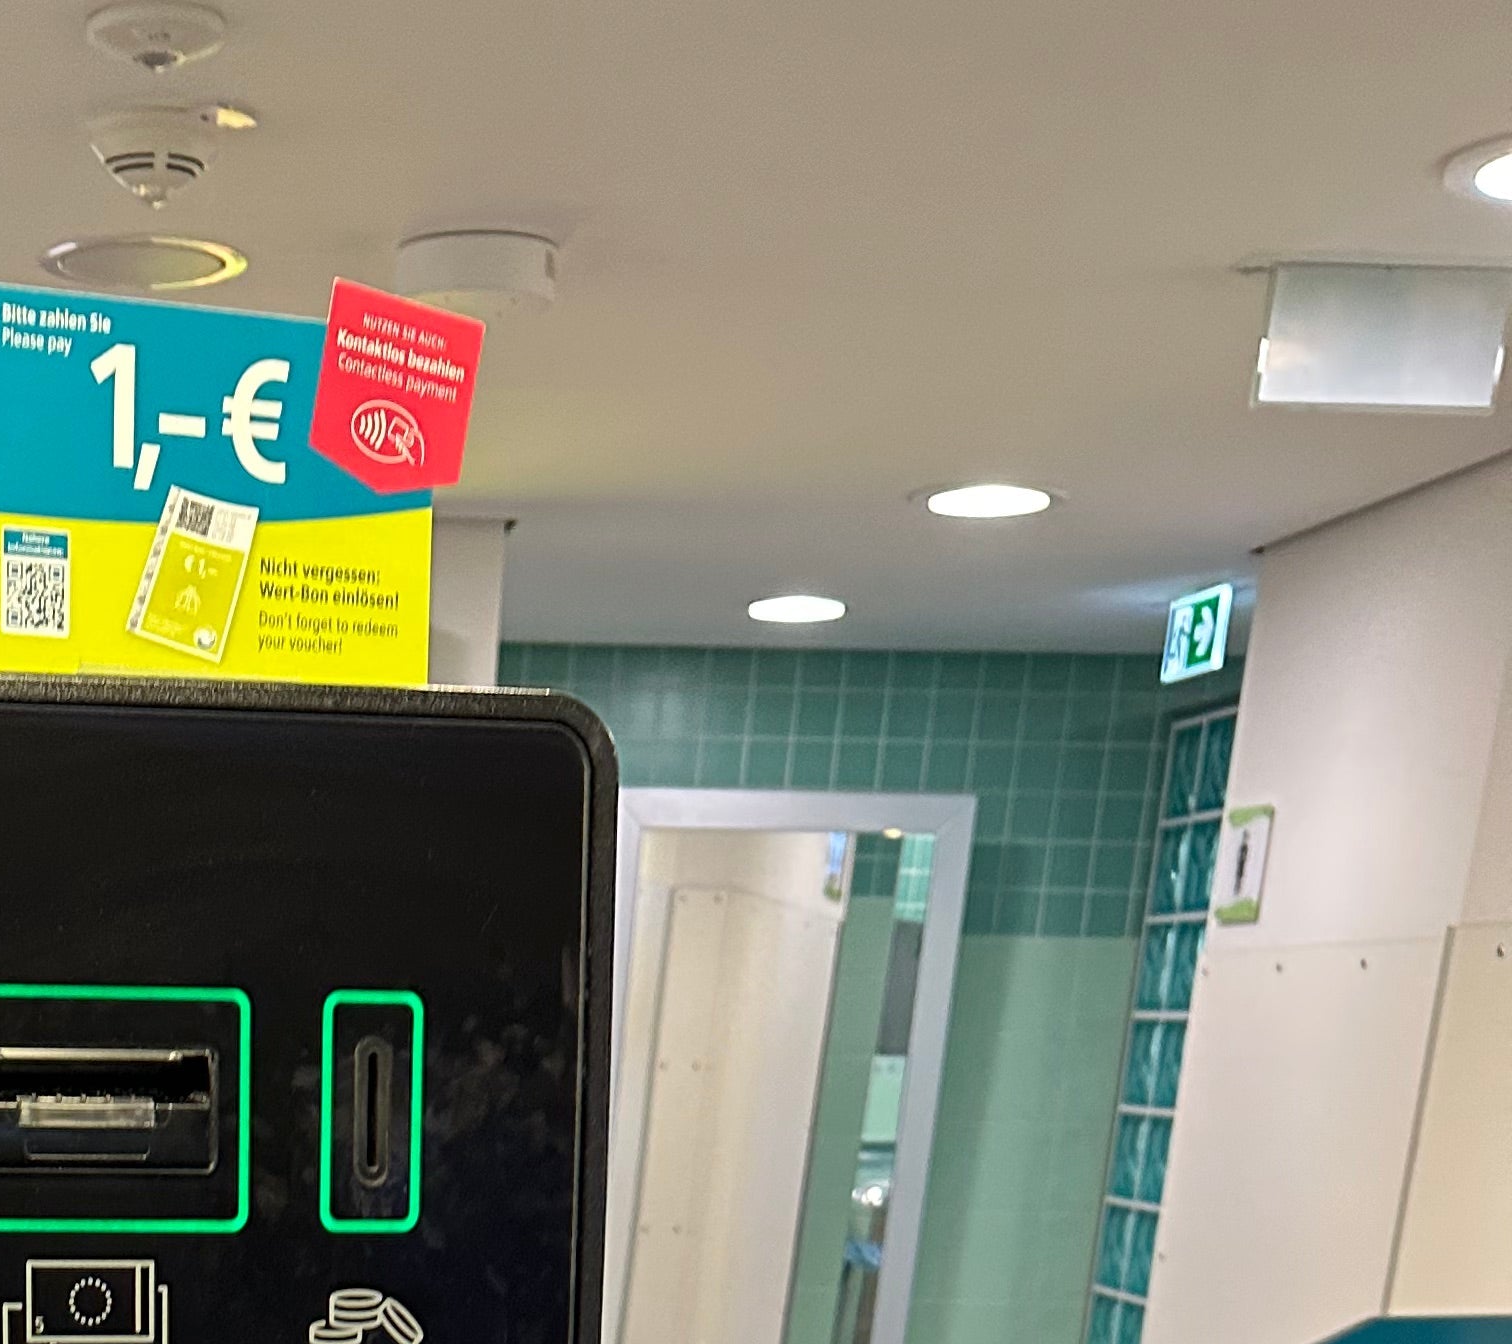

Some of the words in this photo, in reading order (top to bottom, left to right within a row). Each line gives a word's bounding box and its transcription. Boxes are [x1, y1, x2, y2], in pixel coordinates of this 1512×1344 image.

[2, 302, 36, 326] Bitte
[40, 307, 86, 331] zahlen
[90, 312, 111, 334] Sie
[363, 312, 400, 338] NUTZEN
[402, 324, 416, 342] SIE
[2, 326, 44, 352] Please
[48, 335, 72, 357] pay
[336, 326, 406, 366] Kontaktlos
[408, 348, 464, 384] bezahlen
[338, 352, 404, 388] Contactless
[406, 375, 457, 404] payment
[222, 358, 290, 484] €
[260, 557, 297, 578] Nicht
[260, 580, 328, 605] Wert-Bon
[333, 586, 399, 612] einlösen!
[259, 610, 292, 630] Don't
[296, 612, 332, 636] forget
[336, 617, 348, 634] to
[352, 618, 398, 638] redeem
[258, 634, 285, 654] your
[290, 636, 342, 656] voucher!
